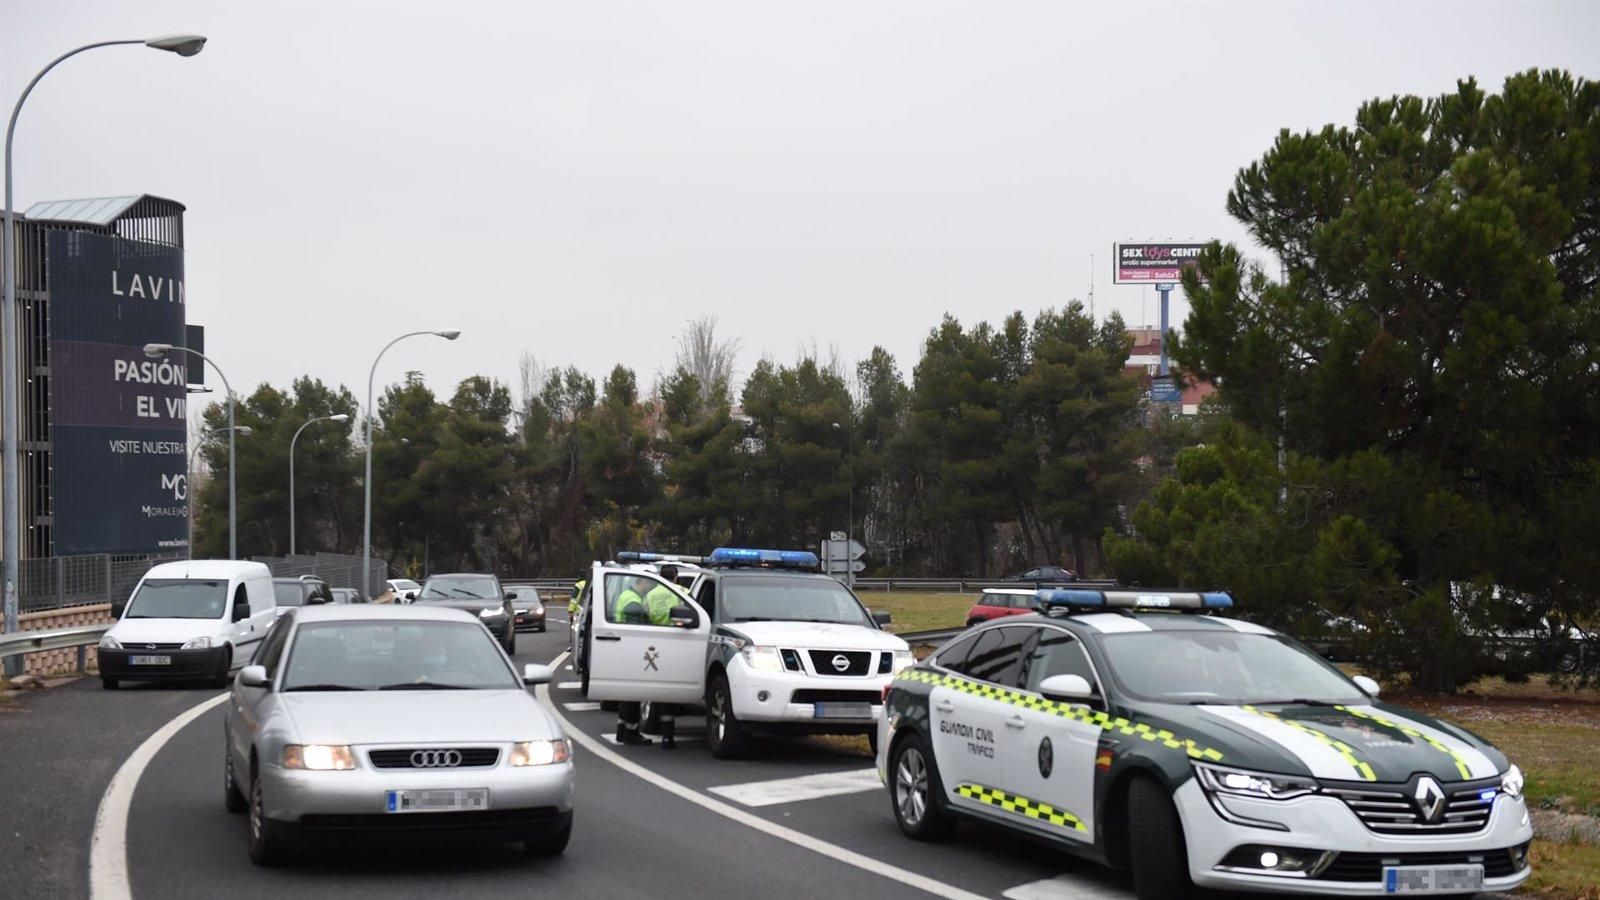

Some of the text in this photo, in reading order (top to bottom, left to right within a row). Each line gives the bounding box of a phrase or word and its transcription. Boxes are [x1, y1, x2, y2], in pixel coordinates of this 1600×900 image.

[114, 358, 184, 386] PASIÓN
[136, 395, 160, 418] EL
[109, 439, 185, 455] VISITE NUESTRA
[940, 720, 995, 744] GUARDIA CIVIL
